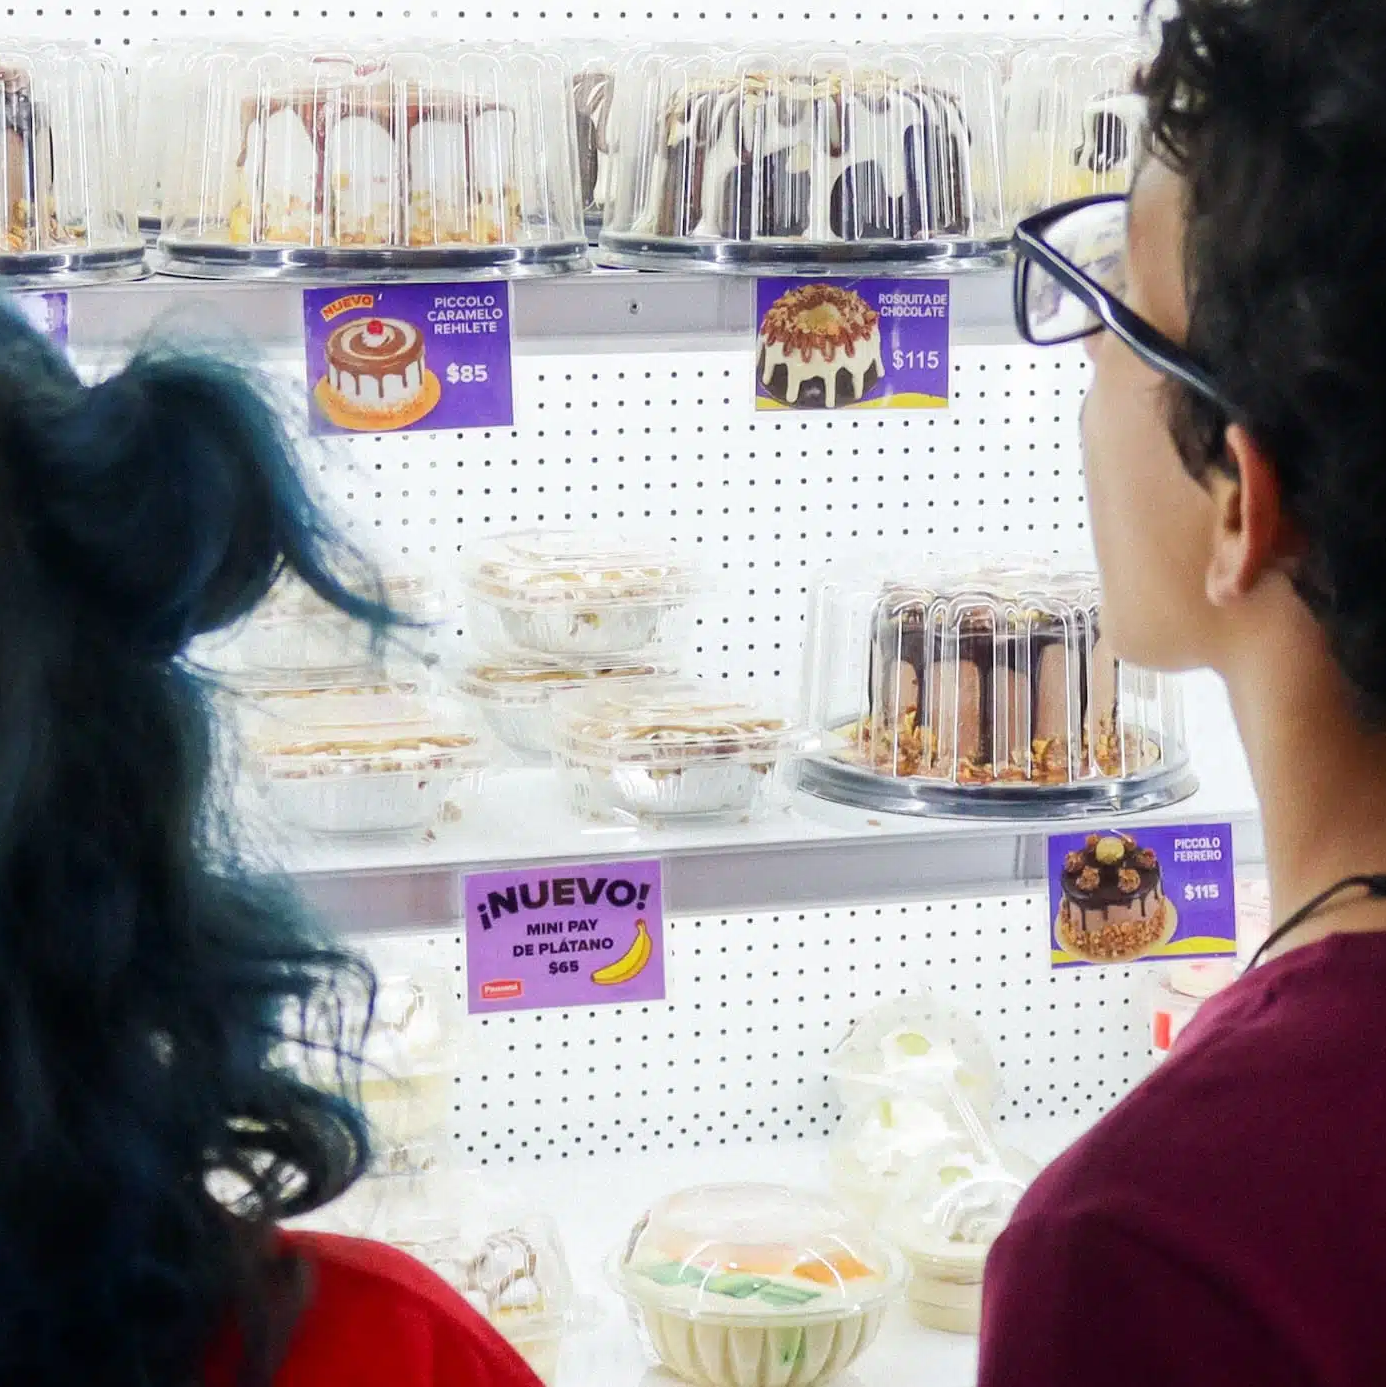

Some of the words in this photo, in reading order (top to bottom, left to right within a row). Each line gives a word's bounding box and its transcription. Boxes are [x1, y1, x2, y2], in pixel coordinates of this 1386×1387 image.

[434, 295, 495, 309] PICCOLO
[878, 293, 931, 305] ROSQUITA
[932, 294, 948, 305] DE
[321, 295, 373, 320] NUEVO
[427, 308, 503, 322] CARAMELO
[880, 305, 945, 318] CHOCOLATE
[434, 321, 498, 335] REHILETE
[892, 350, 940, 370] $115
[446, 363, 488, 384] $85
[1174, 837, 1221, 850] PICCOLO
[1173, 849, 1222, 862] FERRERO
[1184, 884, 1219, 901] $115
[477, 877, 651, 930] ¡NUEVO!
[526, 922, 563, 936] MINI
[567, 919, 599, 933] PAY
[513, 944, 534, 958] DE
[538, 937, 614, 956] PLÁTANO
[548, 960, 580, 975] $65
